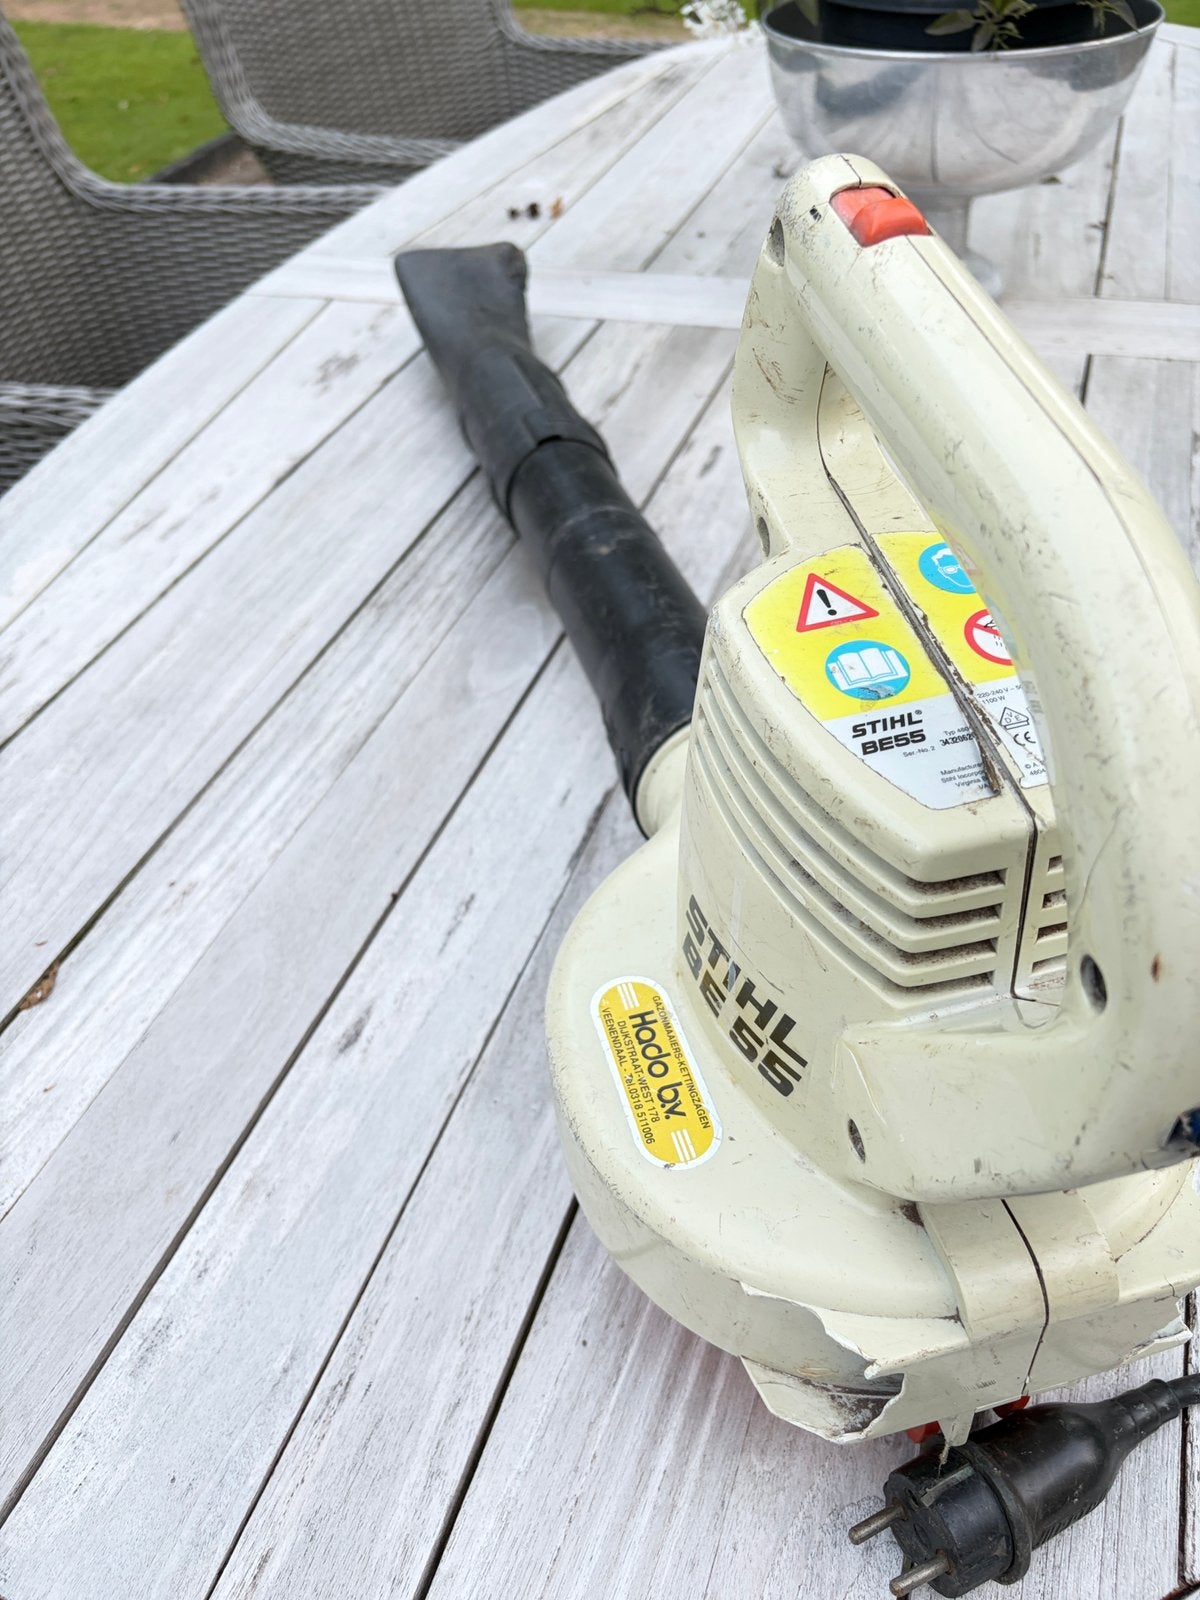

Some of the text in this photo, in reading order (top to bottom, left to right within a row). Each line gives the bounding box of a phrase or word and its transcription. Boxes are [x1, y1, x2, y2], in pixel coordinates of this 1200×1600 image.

[861, 728, 927, 756] BE55
[628, 1010, 672, 1079] Hado
[682, 931, 802, 1097] BE 55
[685, 894, 808, 1068] STIHL
[601, 1007, 627, 1067] VEENENDAAL
[636, 1111, 656, 1145] 511006
[617, 1020, 661, 1123] DIJKSTRAAT-WEST 178
[652, 995, 711, 1130] GAZONMAAIERS-KETTINGZAGEN
